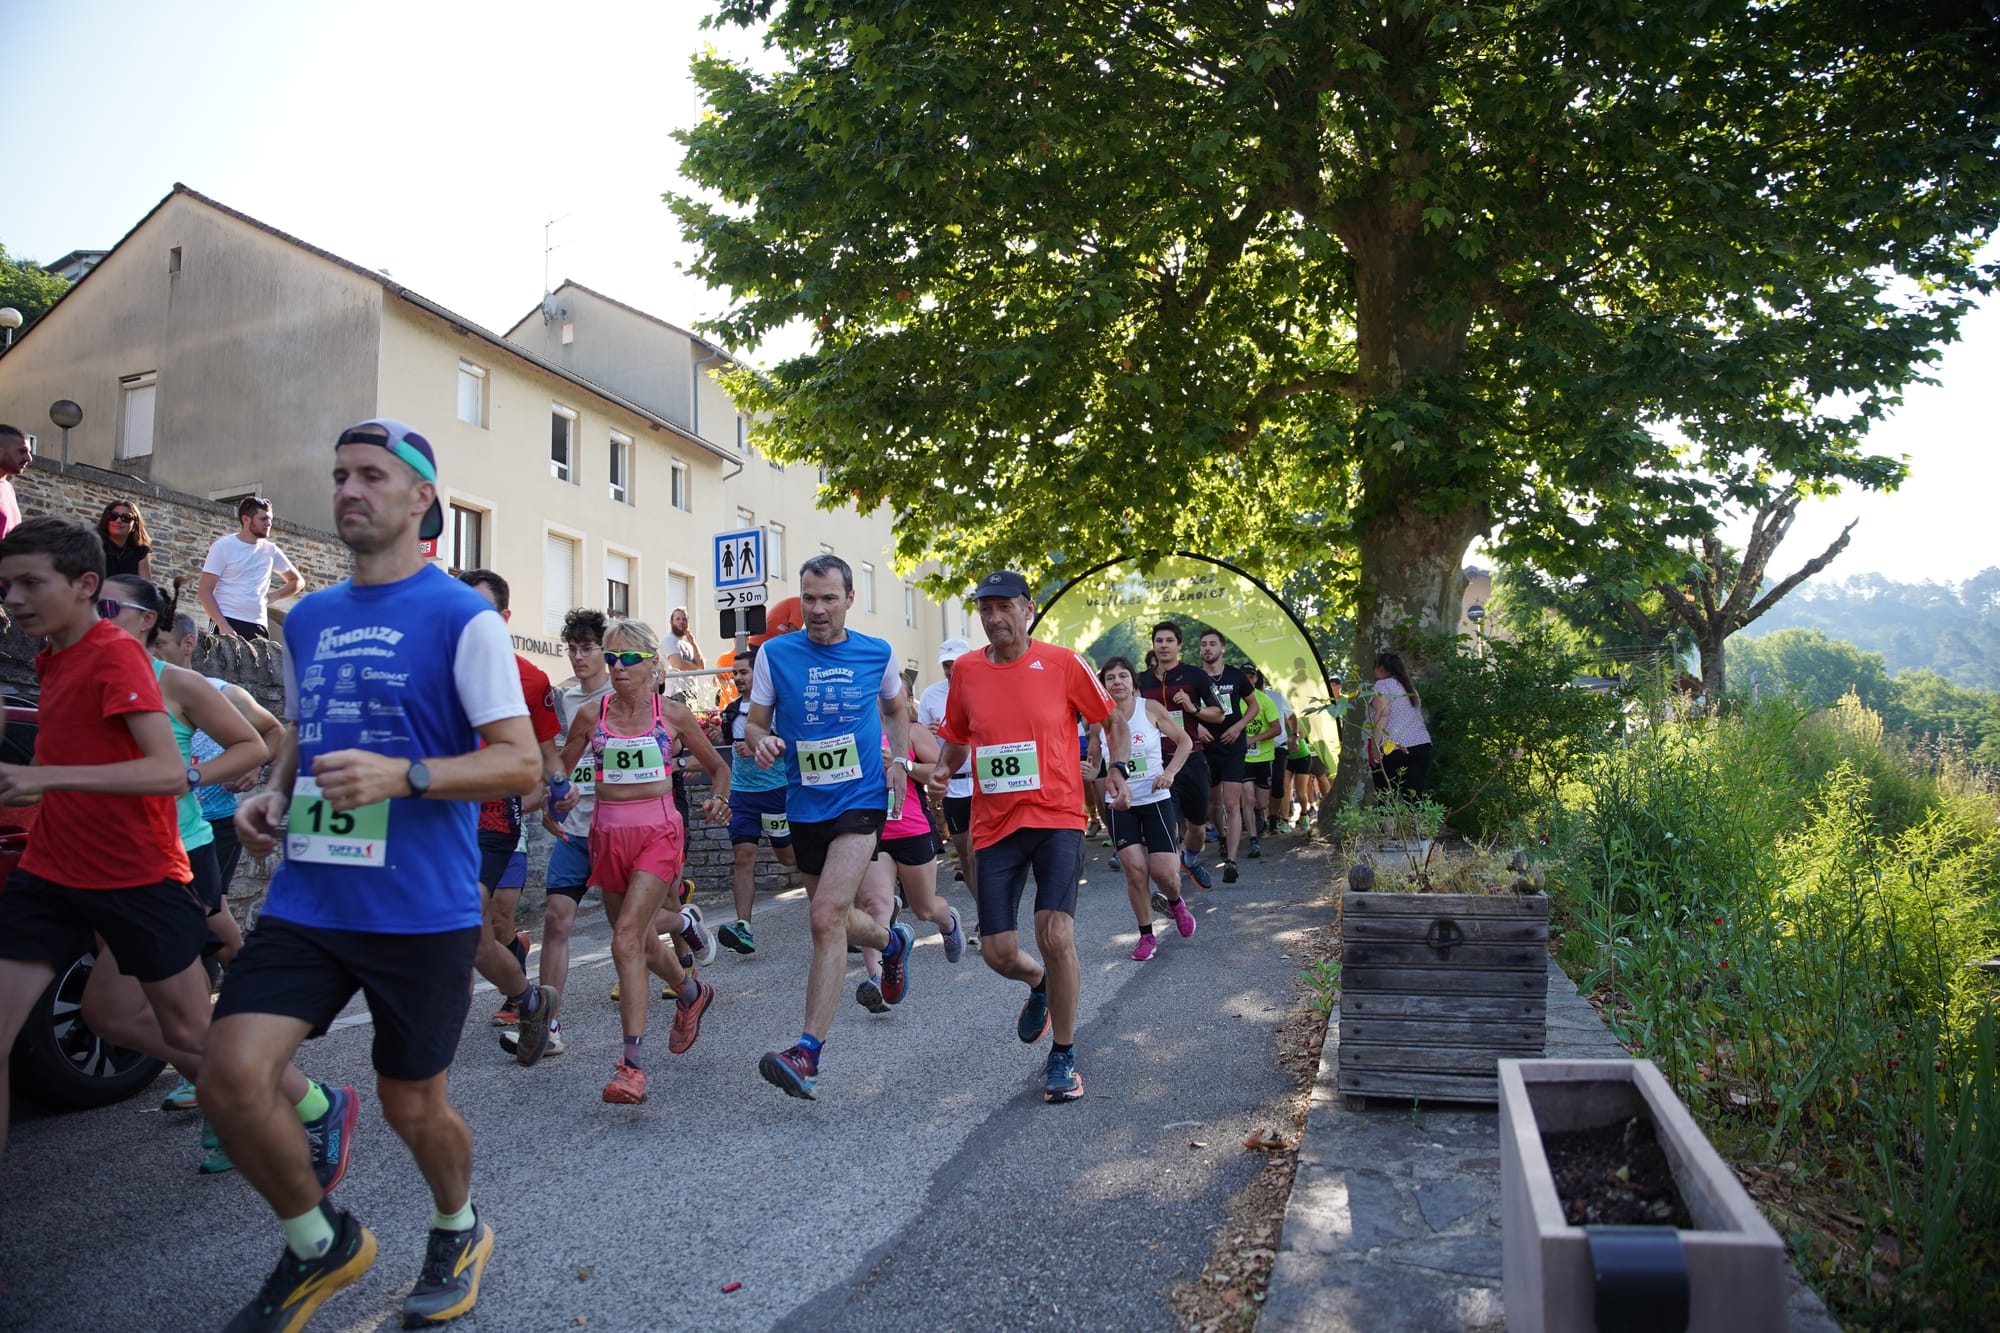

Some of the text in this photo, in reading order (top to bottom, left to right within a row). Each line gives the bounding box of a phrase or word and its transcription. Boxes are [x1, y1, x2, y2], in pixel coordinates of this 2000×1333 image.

[1188, 573, 1215, 584] des
[739, 592, 753, 602] 50
[616, 749, 644, 769] 81
[805, 748, 848, 771] 107
[991, 757, 1020, 777] 88
[574, 767, 592, 782] 26
[307, 800, 355, 835] 15
[770, 820, 787, 830] 97
